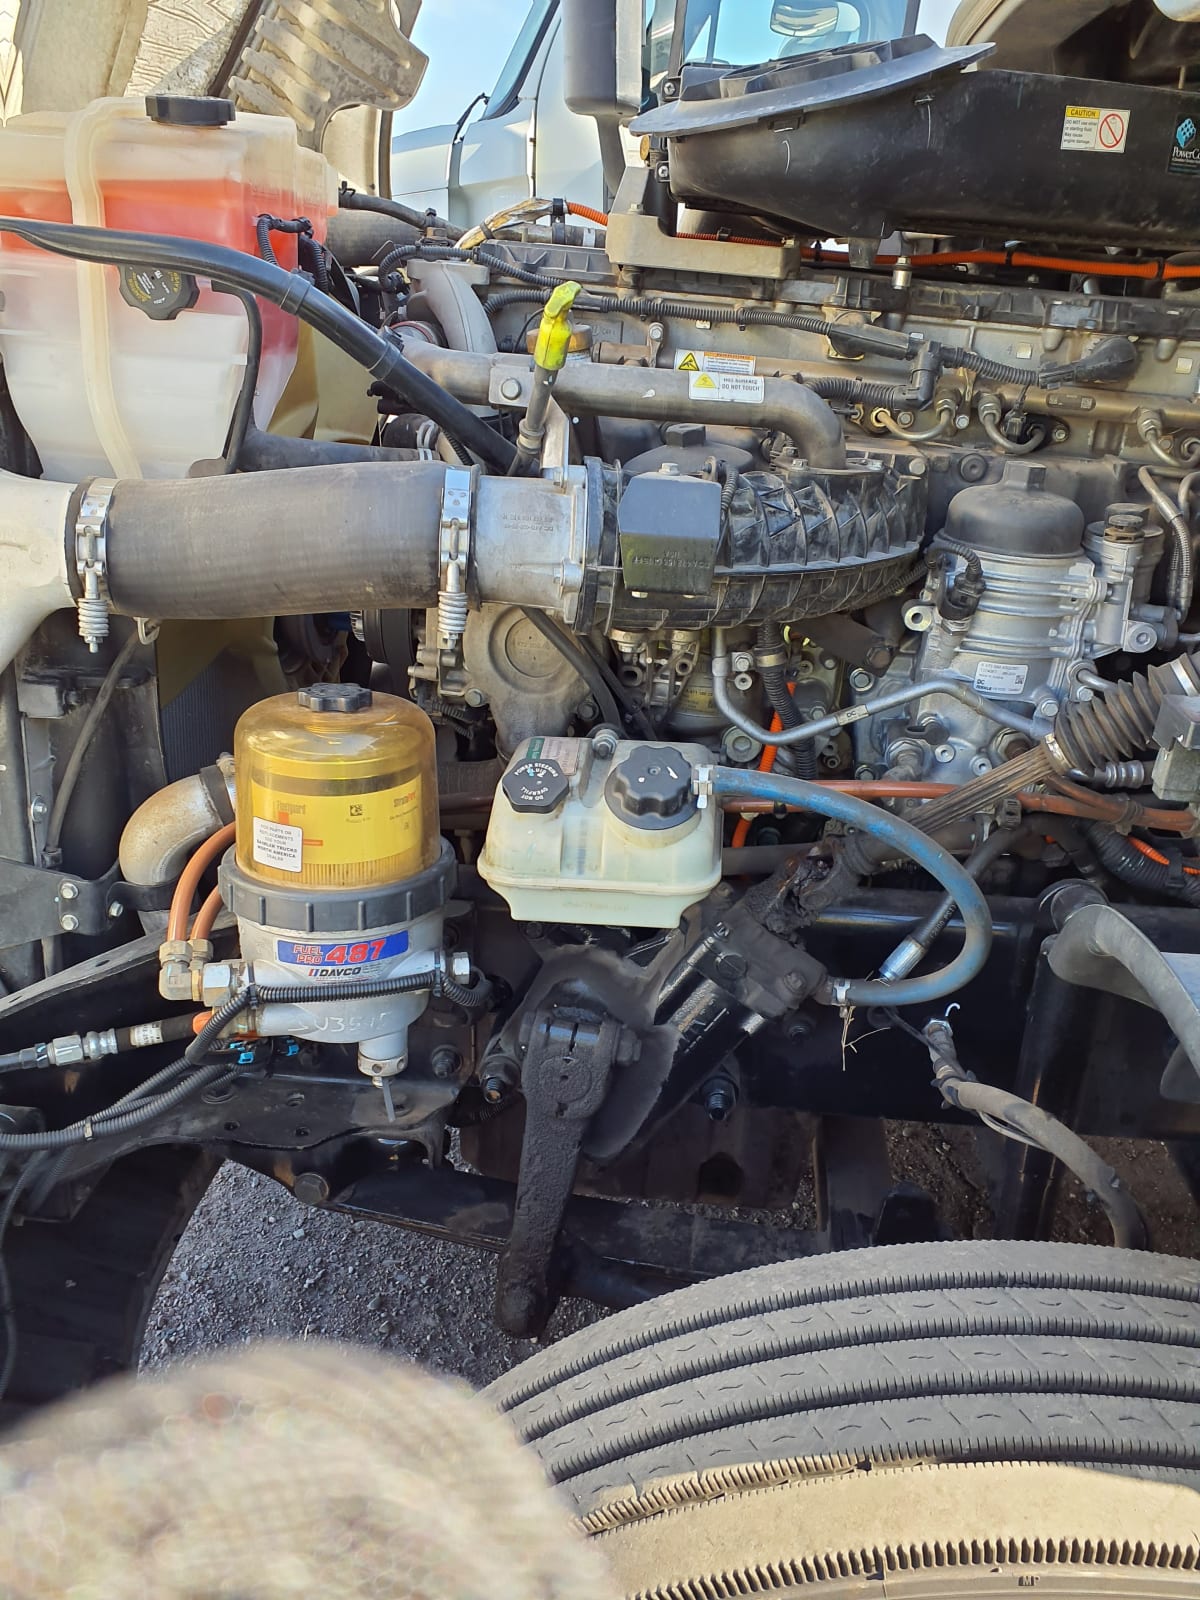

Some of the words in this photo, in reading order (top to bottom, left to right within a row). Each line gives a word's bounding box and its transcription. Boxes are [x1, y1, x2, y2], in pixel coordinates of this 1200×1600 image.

[1070, 109, 1096, 117] CAUTION
[514, 763, 533, 776] POWER
[534, 762, 559, 777] STEERING
[520, 787, 548, 795] OVERFILL
[259, 829, 294, 841] REPLACEMENTS
[270, 826, 284, 834] PARTS
[257, 845, 272, 853] NORTH
[273, 850, 296, 858] AMERICA
[276, 845, 297, 853] TRUCKS
[266, 853, 284, 861] DEALER
[293, 944, 323, 955] FUEL
[325, 939, 386, 965] 487
[297, 954, 322, 965] PRO
[319, 967, 361, 977] DAVCO
